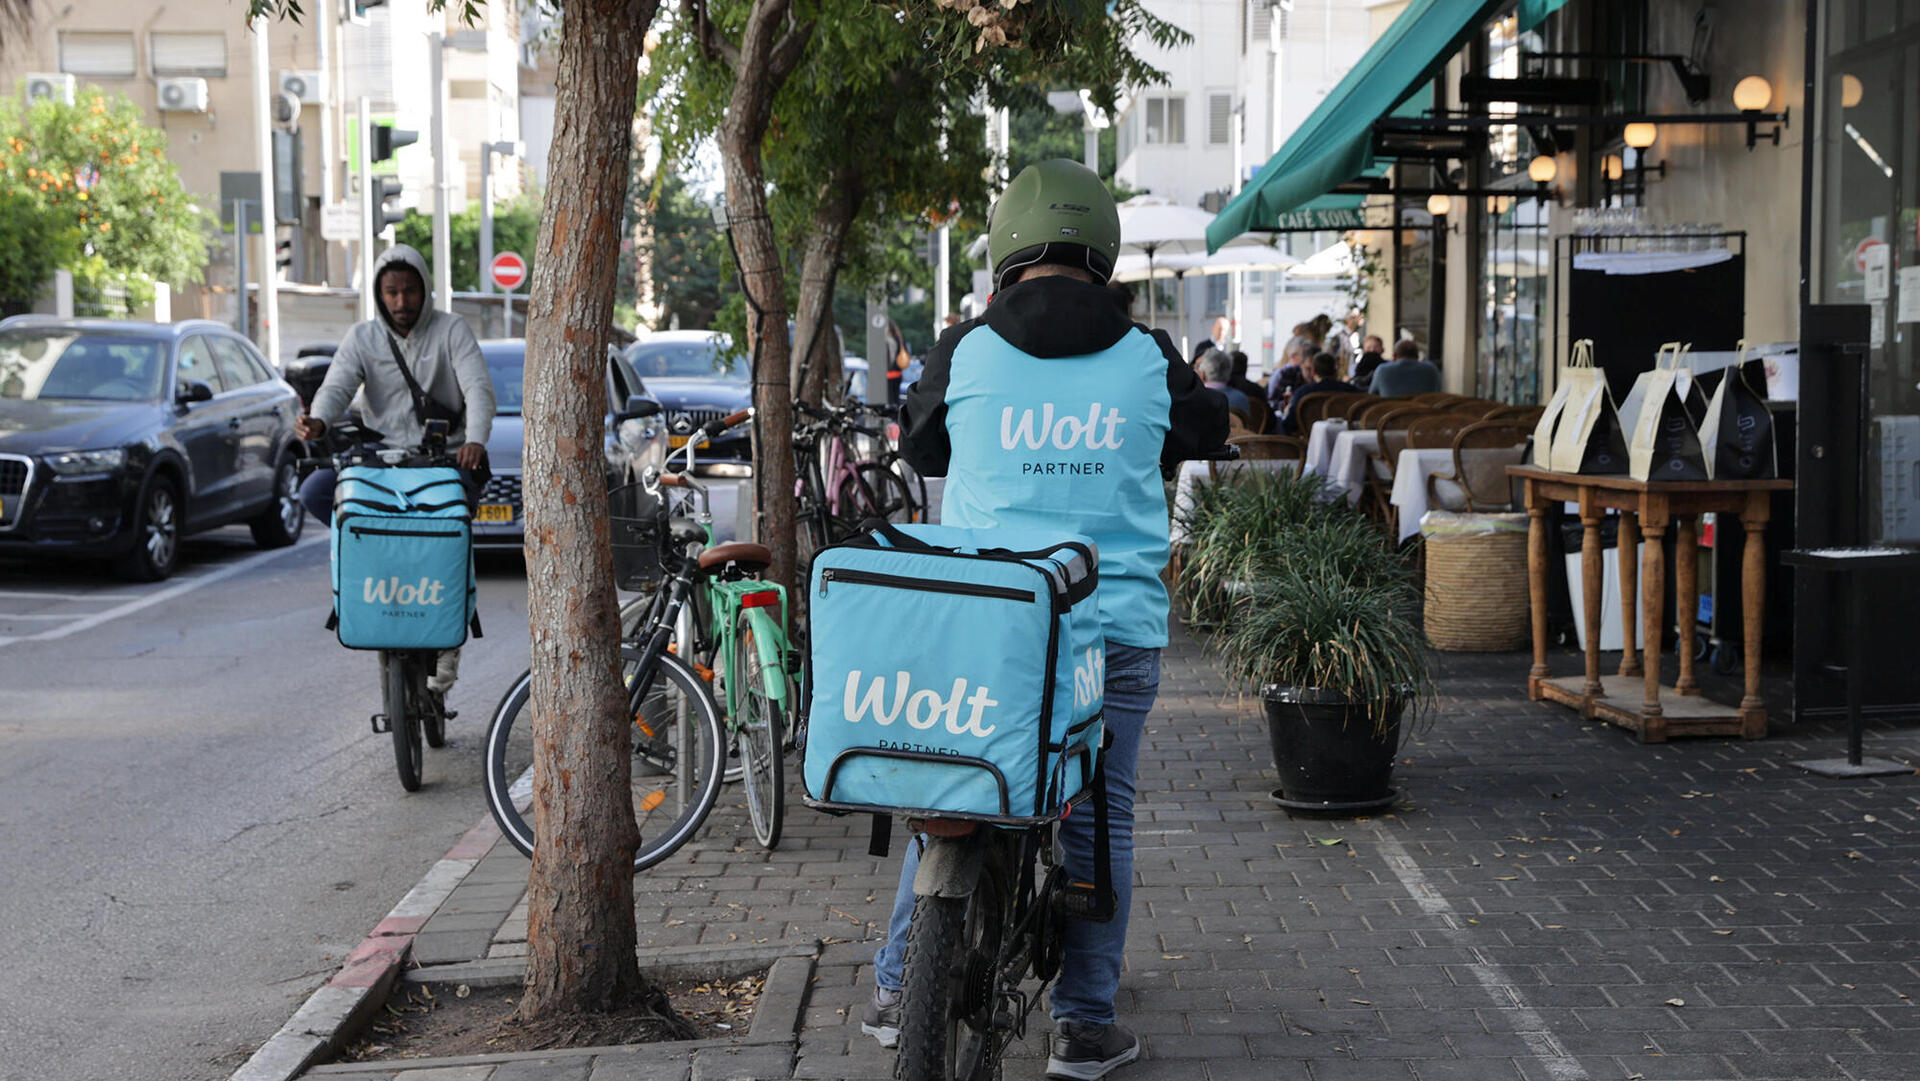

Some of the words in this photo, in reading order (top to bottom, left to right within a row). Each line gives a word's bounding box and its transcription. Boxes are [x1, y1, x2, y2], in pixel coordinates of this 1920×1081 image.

[1278, 208, 1316, 229] CAFÉ
[1000, 402, 1127, 450] Wolt
[1022, 462, 1105, 475] PARTNER
[363, 576, 445, 606] Wolt
[381, 610, 426, 618] PARTNER
[1073, 646, 1105, 710] olt
[843, 670, 999, 738] Wolt
